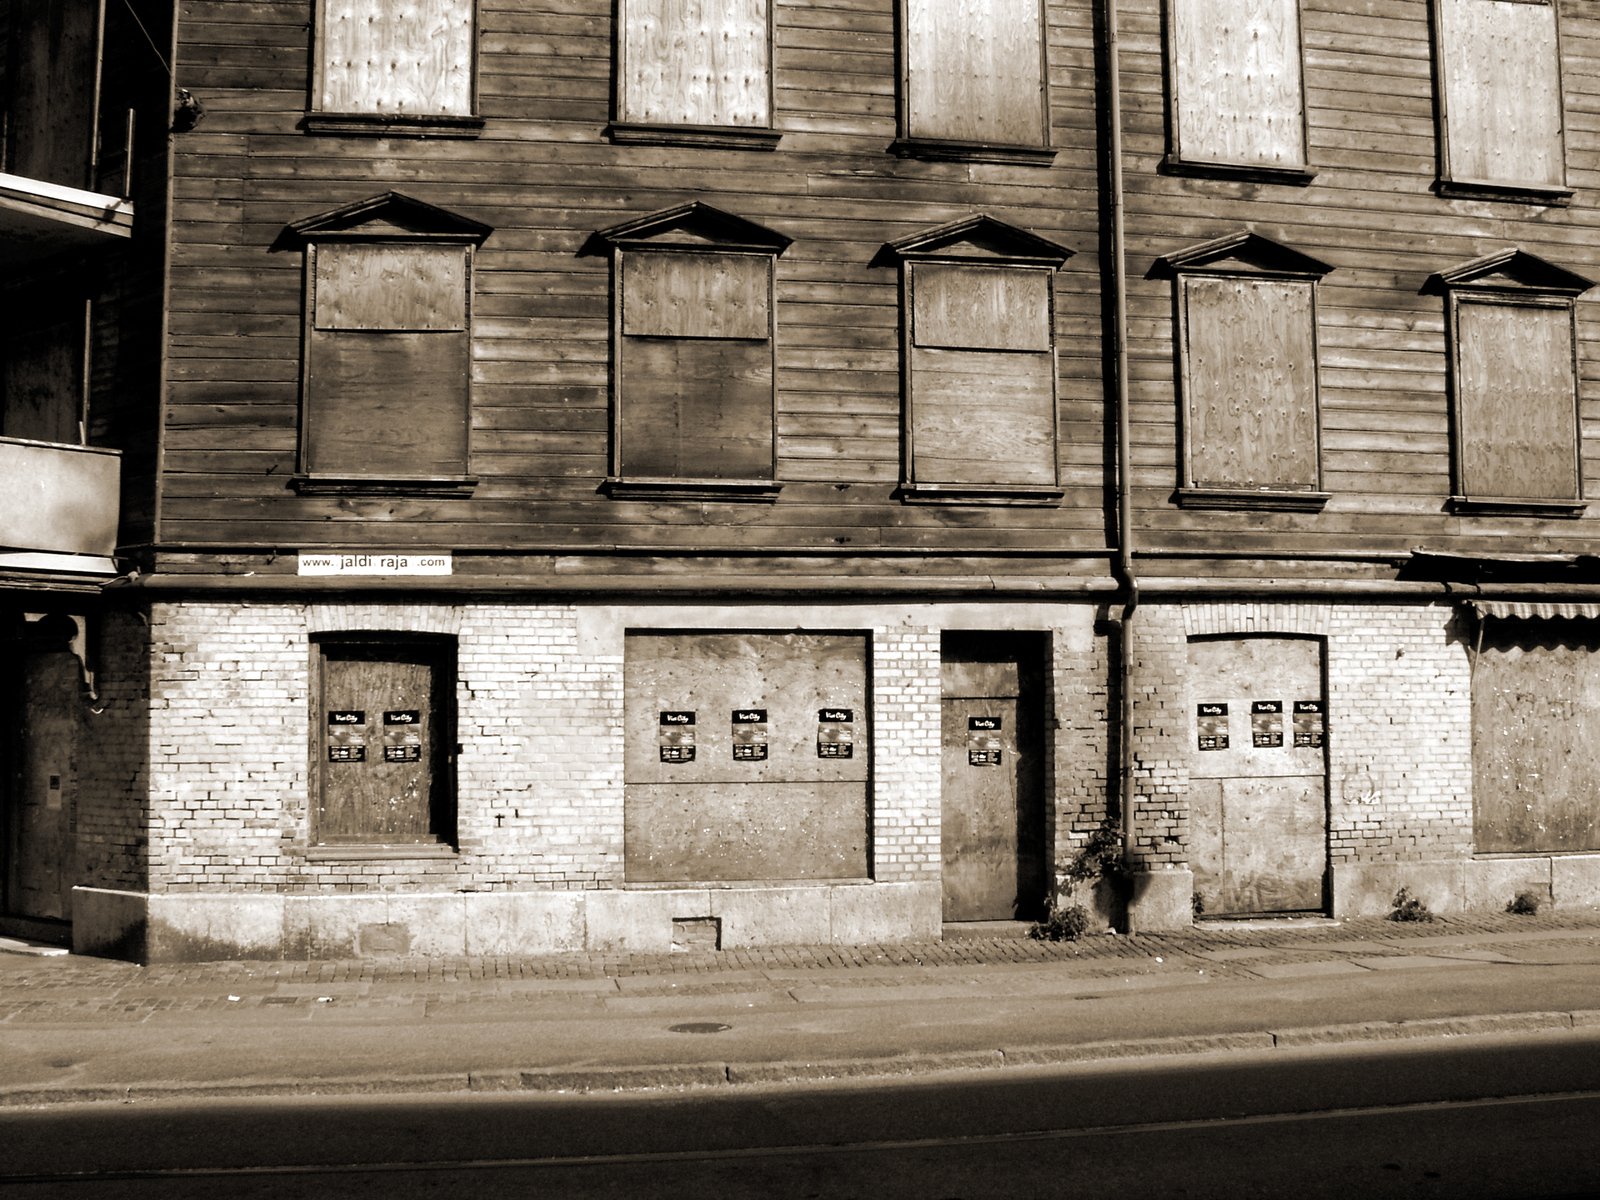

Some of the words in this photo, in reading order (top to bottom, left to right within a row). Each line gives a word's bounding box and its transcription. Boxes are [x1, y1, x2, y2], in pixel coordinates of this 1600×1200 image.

[303, 558, 334, 567] www.
[340, 555, 372, 570] jaldi
[380, 555, 408, 570] raja
[416, 558, 445, 567] .com
